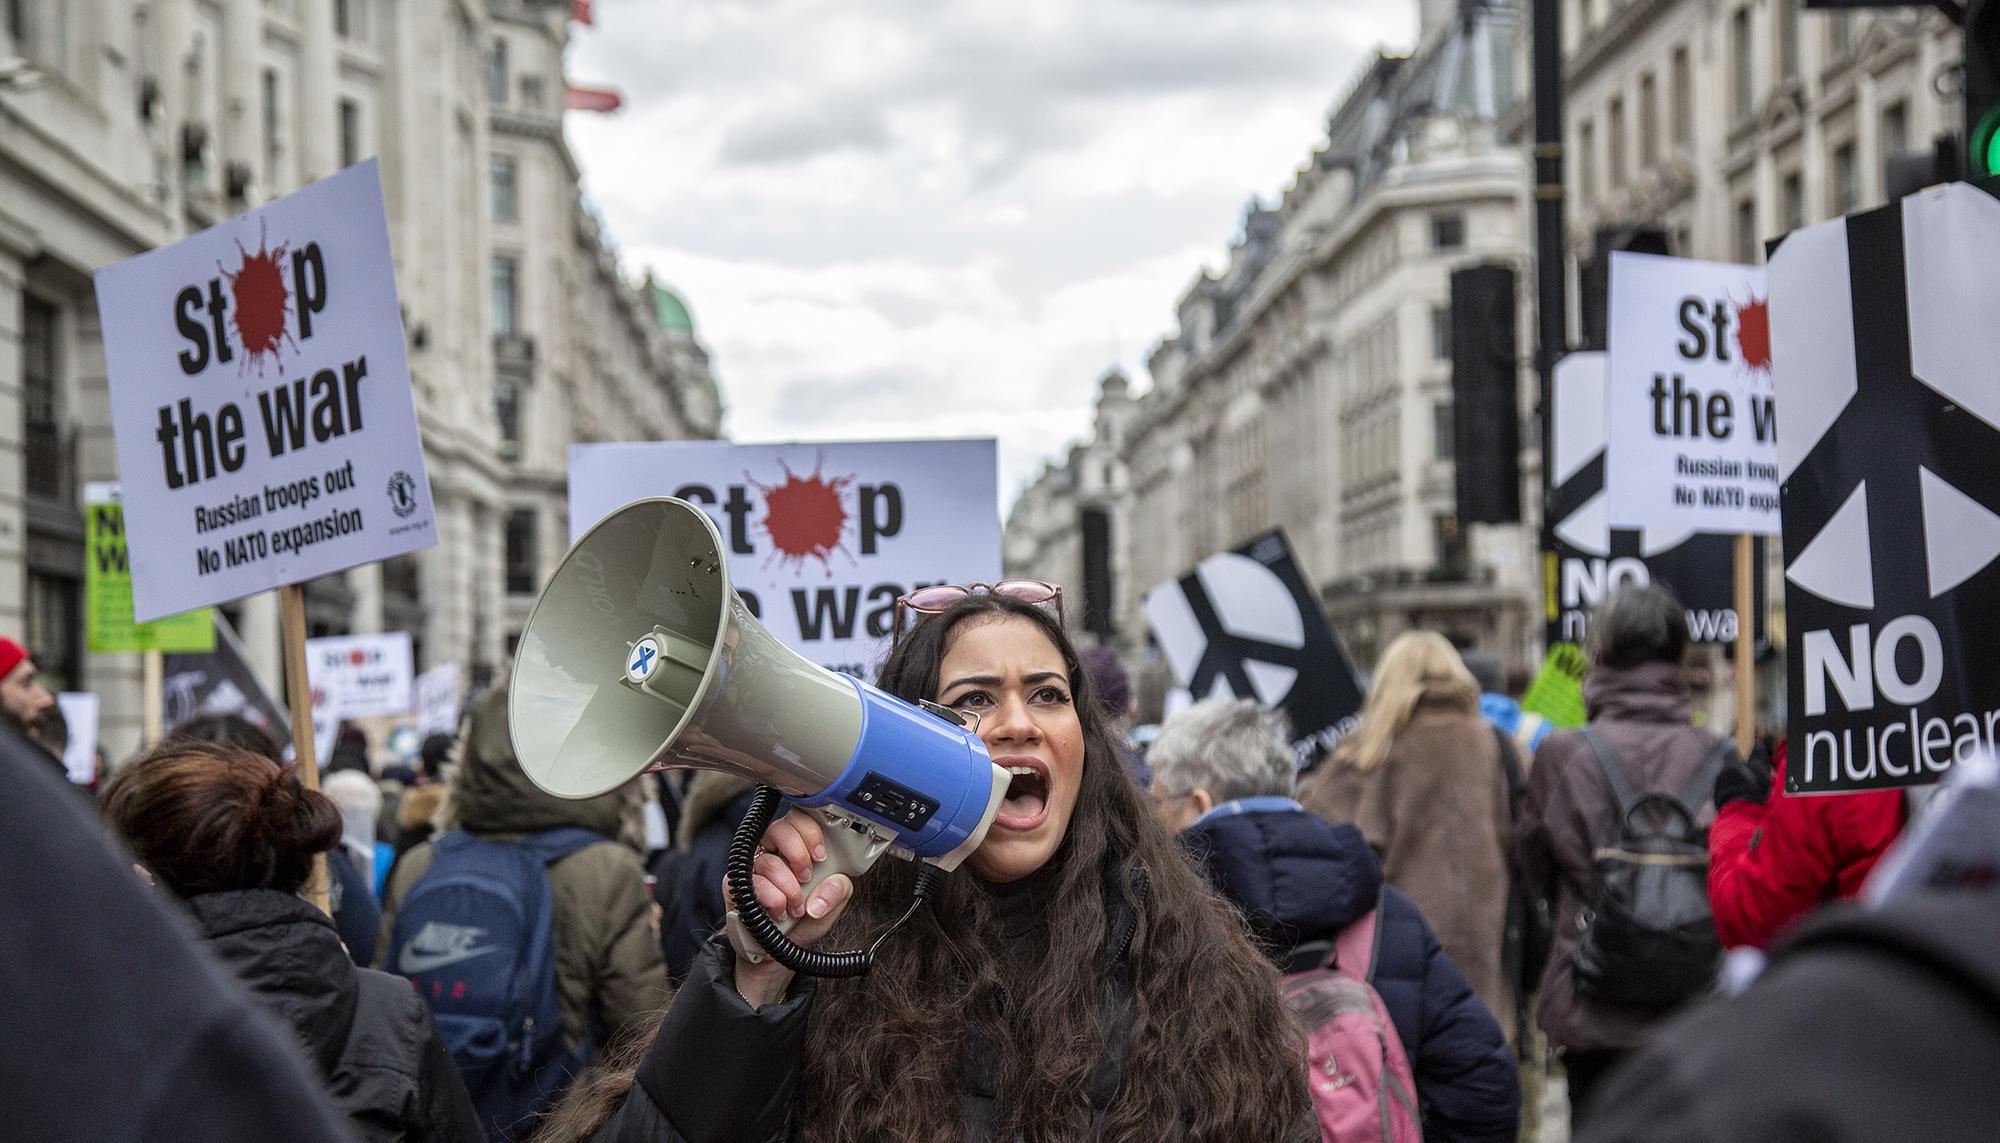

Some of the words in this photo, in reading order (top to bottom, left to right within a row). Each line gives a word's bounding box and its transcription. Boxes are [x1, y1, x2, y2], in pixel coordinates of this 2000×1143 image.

[156, 397, 246, 490] the
[258, 354, 367, 459] war
[1650, 373, 1734, 439] the
[195, 493, 261, 533] Russian
[264, 476, 320, 512] troops
[325, 460, 355, 494] out
[1674, 486, 1697, 506] No
[1703, 485, 1744, 508] NATO
[1677, 453, 1742, 476] Russian
[1748, 456, 1778, 481] troo
[196, 546, 221, 576] No
[224, 532, 267, 571] NATO
[272, 508, 364, 555] expansion
[1685, 608, 1739, 642] wa
[1802, 614, 1944, 717] NO
